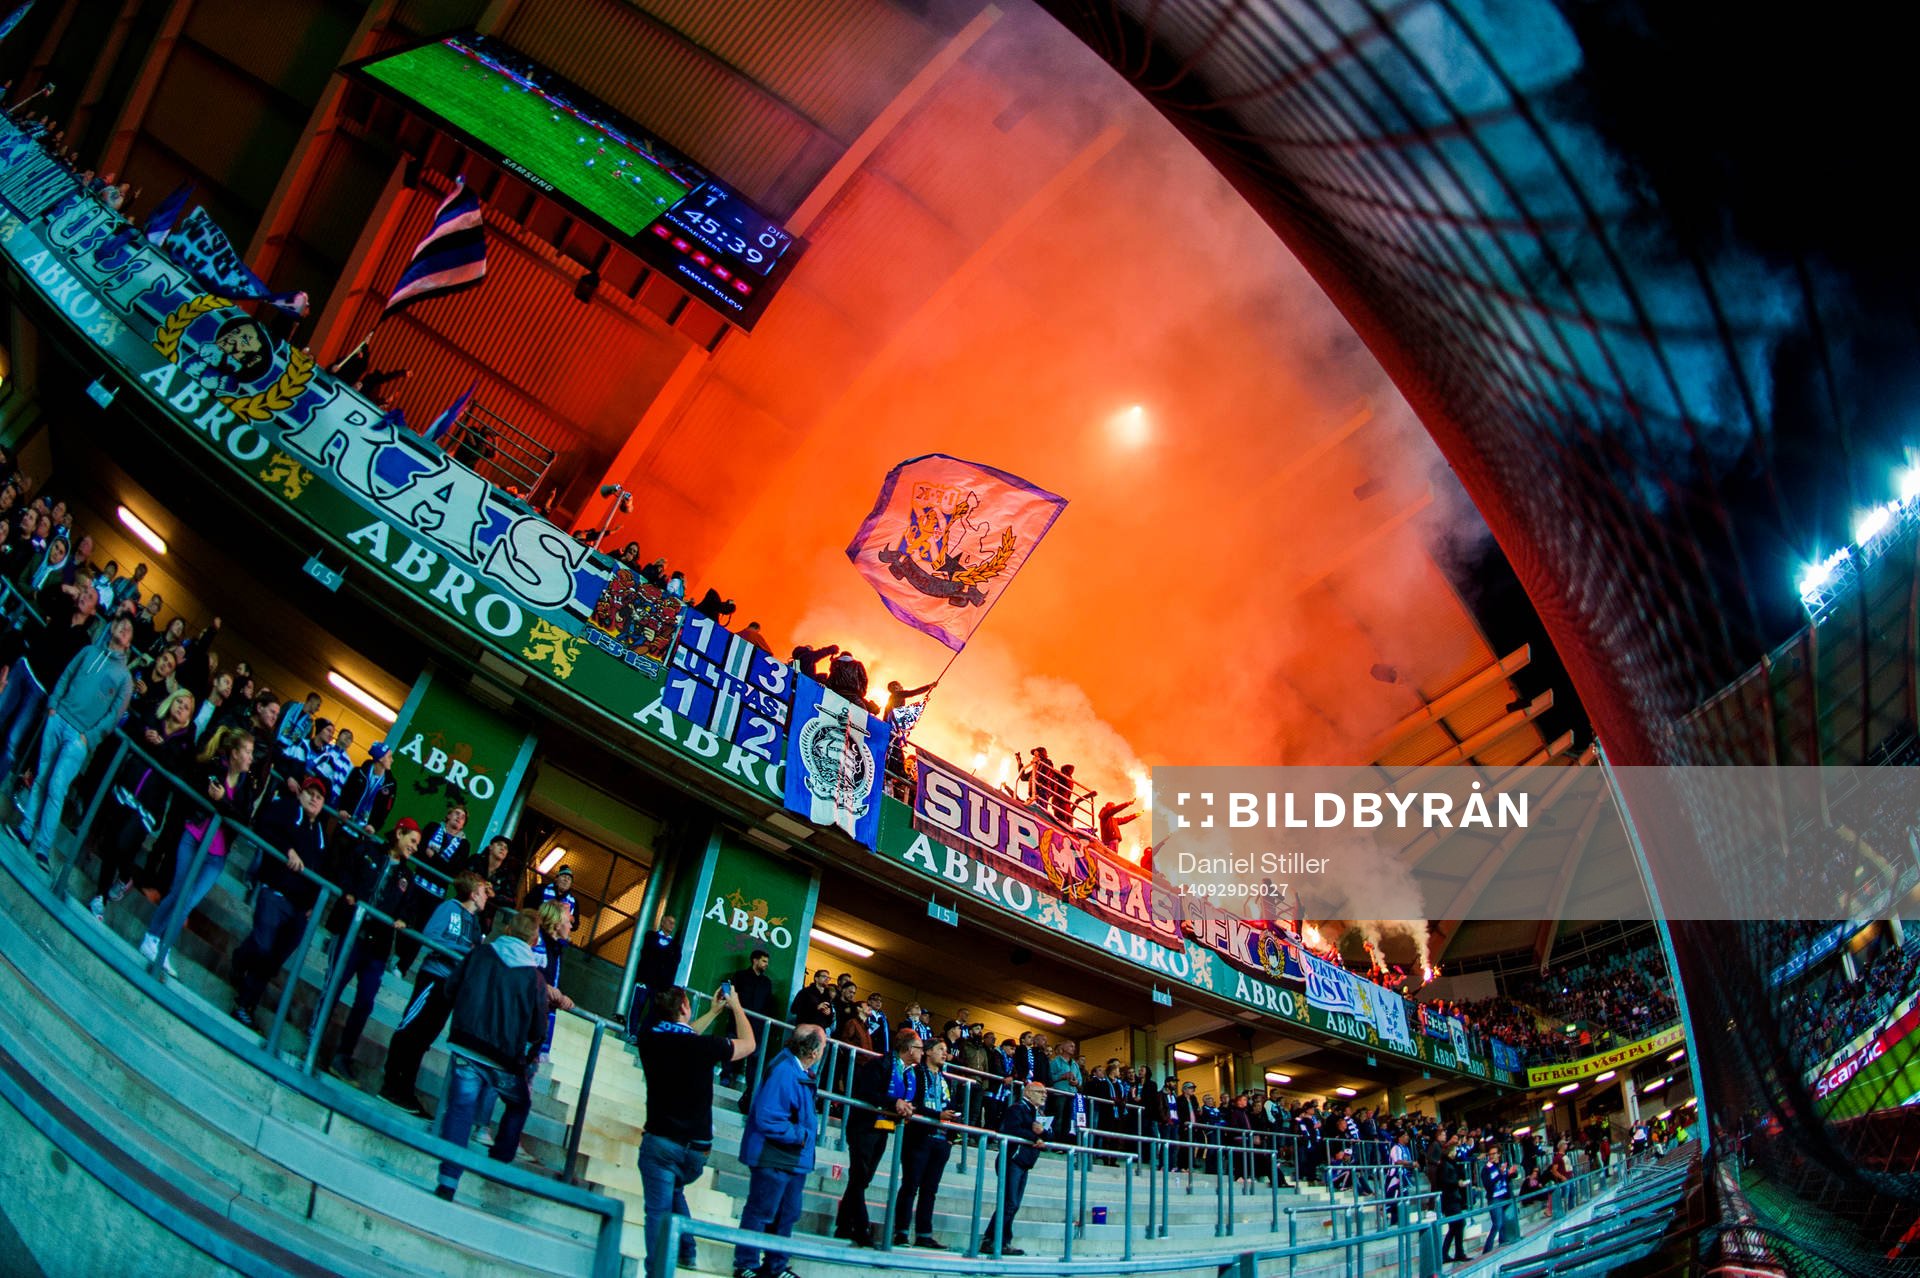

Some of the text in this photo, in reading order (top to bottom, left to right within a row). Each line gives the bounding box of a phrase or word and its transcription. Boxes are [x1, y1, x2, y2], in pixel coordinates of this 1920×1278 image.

[502, 158, 554, 191] SAMSUNG
[683, 209, 764, 263] 45:39
[704, 195, 718, 207] 1
[758, 233, 777, 248] 0
[708, 184, 790, 241] IFK DIF
[282, 383, 590, 607] RAS
[691, 617, 786, 694] 1 3
[683, 650, 779, 720] ULTRAS
[671, 678, 776, 760] 1 2
[400, 733, 496, 800] ÅBRO
[924, 770, 1040, 861] SUP
[704, 896, 792, 949] ÅBRO
[1235, 971, 1294, 1016] ÅBRO
[1531, 1071, 1550, 1083] GT
[1552, 1065, 1580, 1080] BÄST
[1583, 1062, 1590, 1073] I
[1592, 1051, 1627, 1069] VÄST
[1629, 1045, 1645, 1058] PÅ
[1816, 1041, 1883, 1097] Scandic
